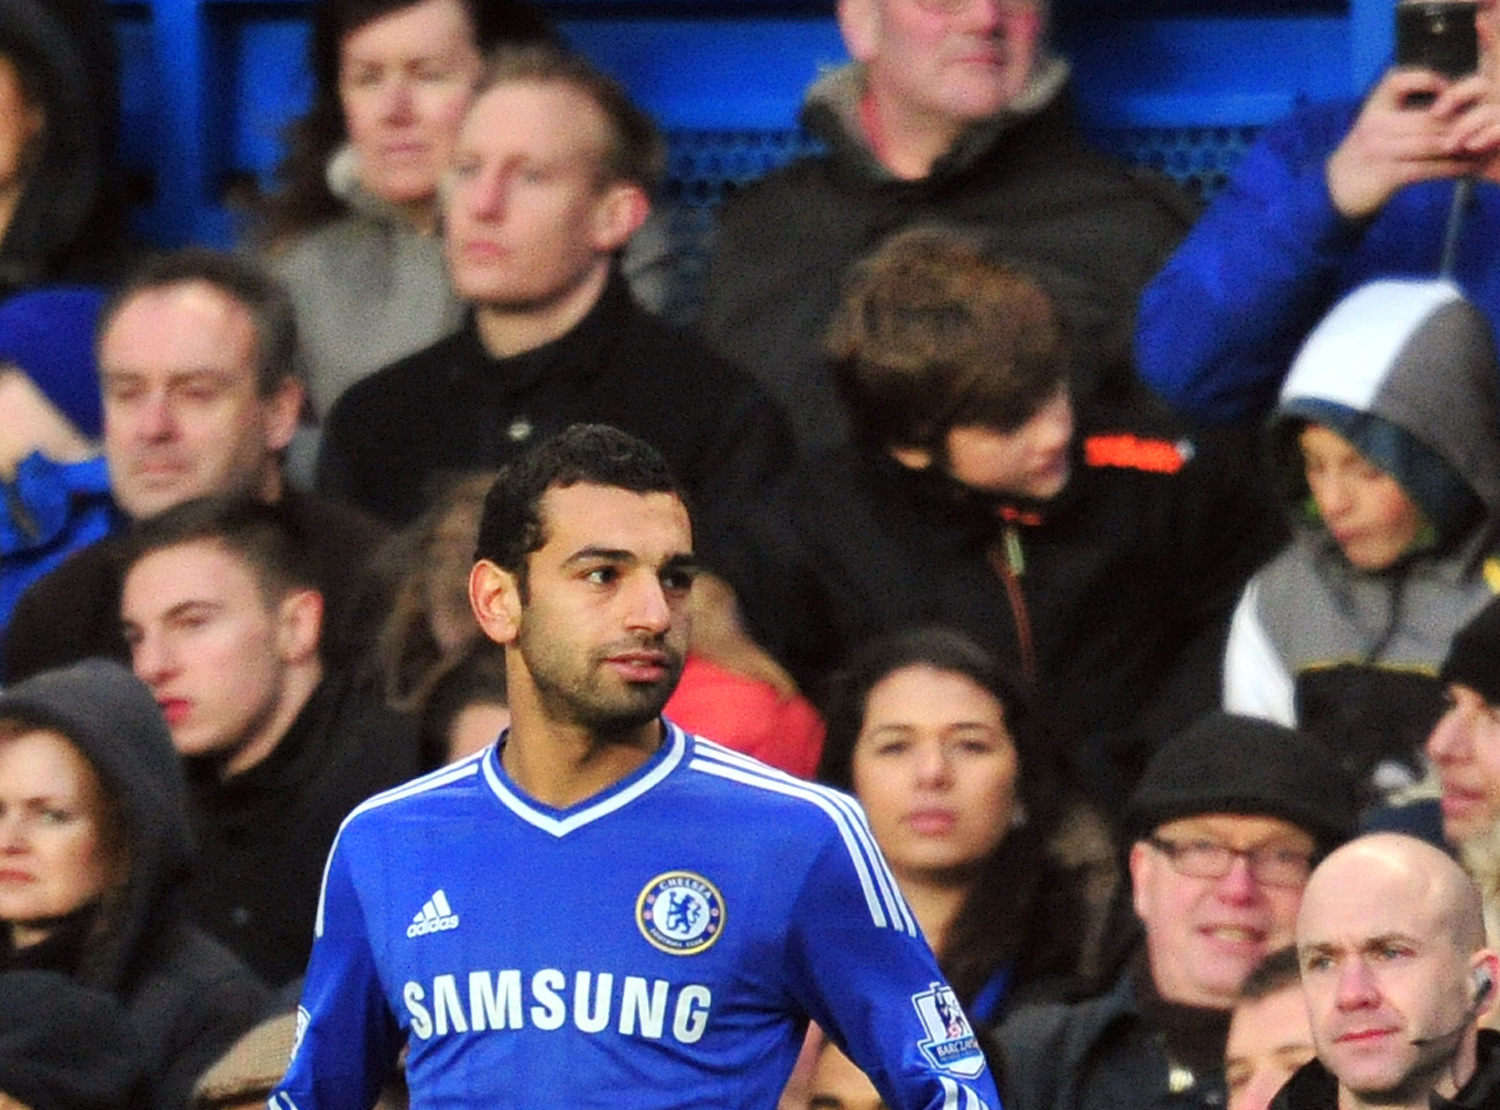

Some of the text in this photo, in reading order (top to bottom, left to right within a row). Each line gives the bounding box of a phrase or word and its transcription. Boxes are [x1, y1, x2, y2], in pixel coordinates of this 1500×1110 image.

[658, 877, 713, 899] CHELSEA
[406, 914, 460, 939] adidas
[403, 968, 712, 1044] SAMSUNG
